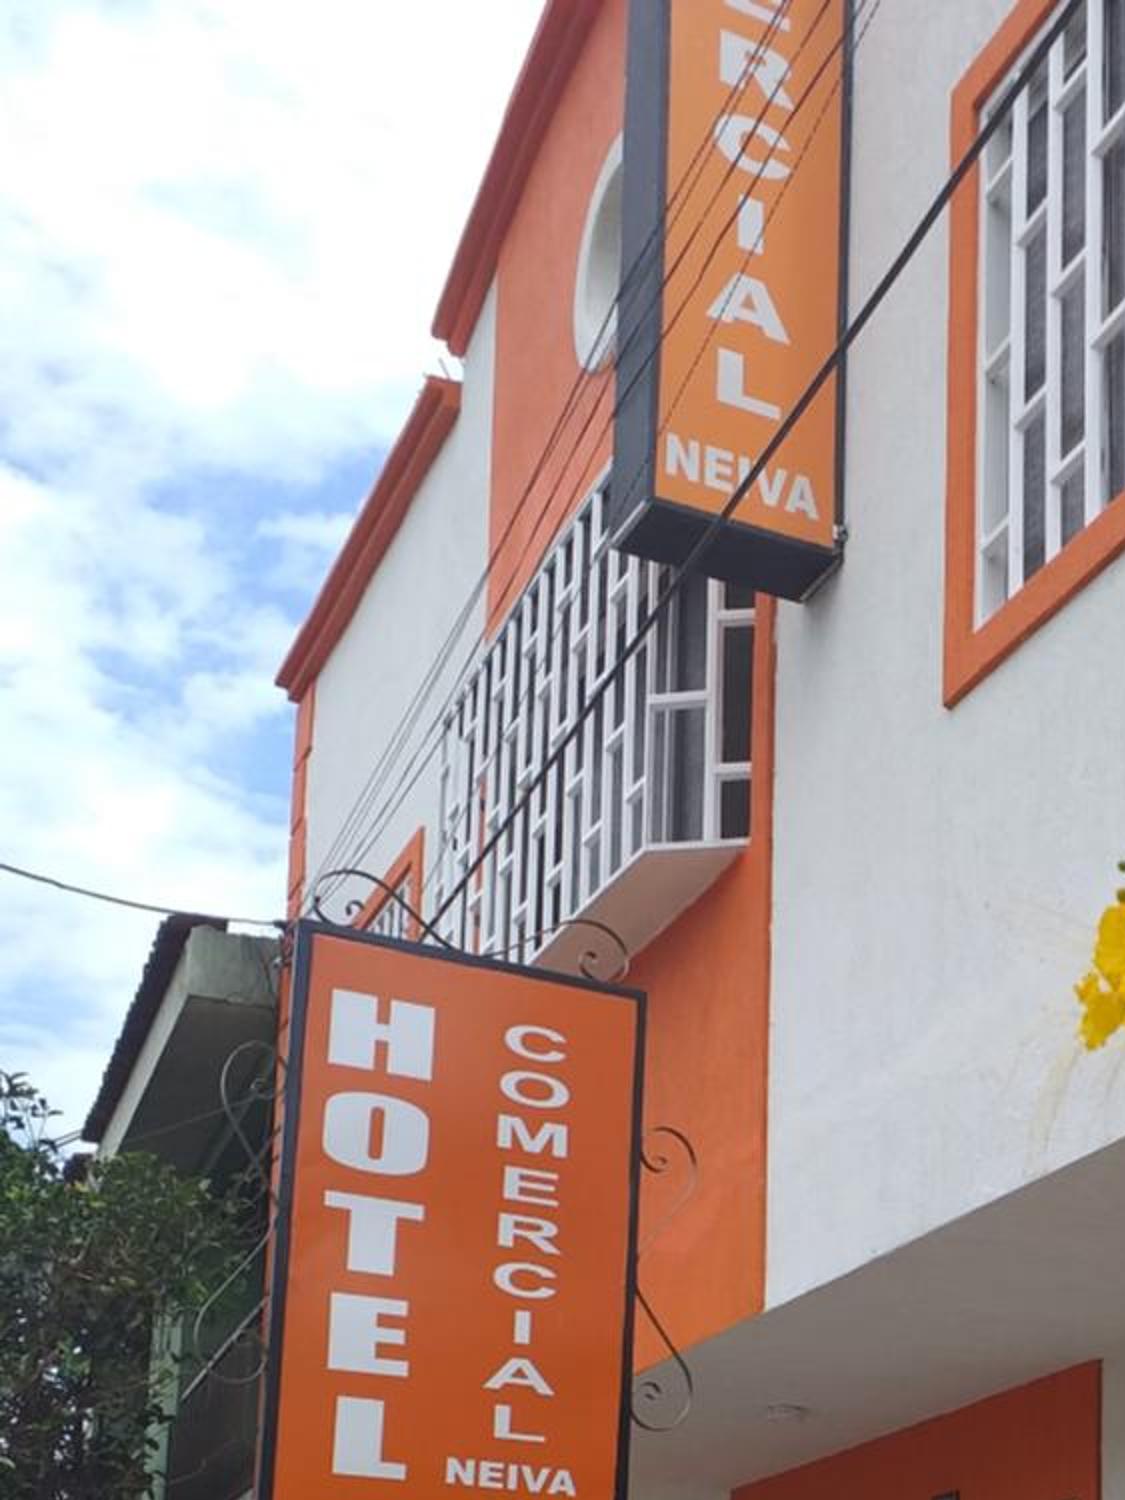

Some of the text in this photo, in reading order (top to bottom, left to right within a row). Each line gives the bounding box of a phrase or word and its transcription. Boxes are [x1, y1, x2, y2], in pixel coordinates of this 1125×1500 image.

[664, 431, 819, 520] NEIVA
[322, 988, 437, 1480] HOTEL
[483, 1025, 571, 1443] COMERCIAL
[445, 1457, 576, 1497] NEIVA
